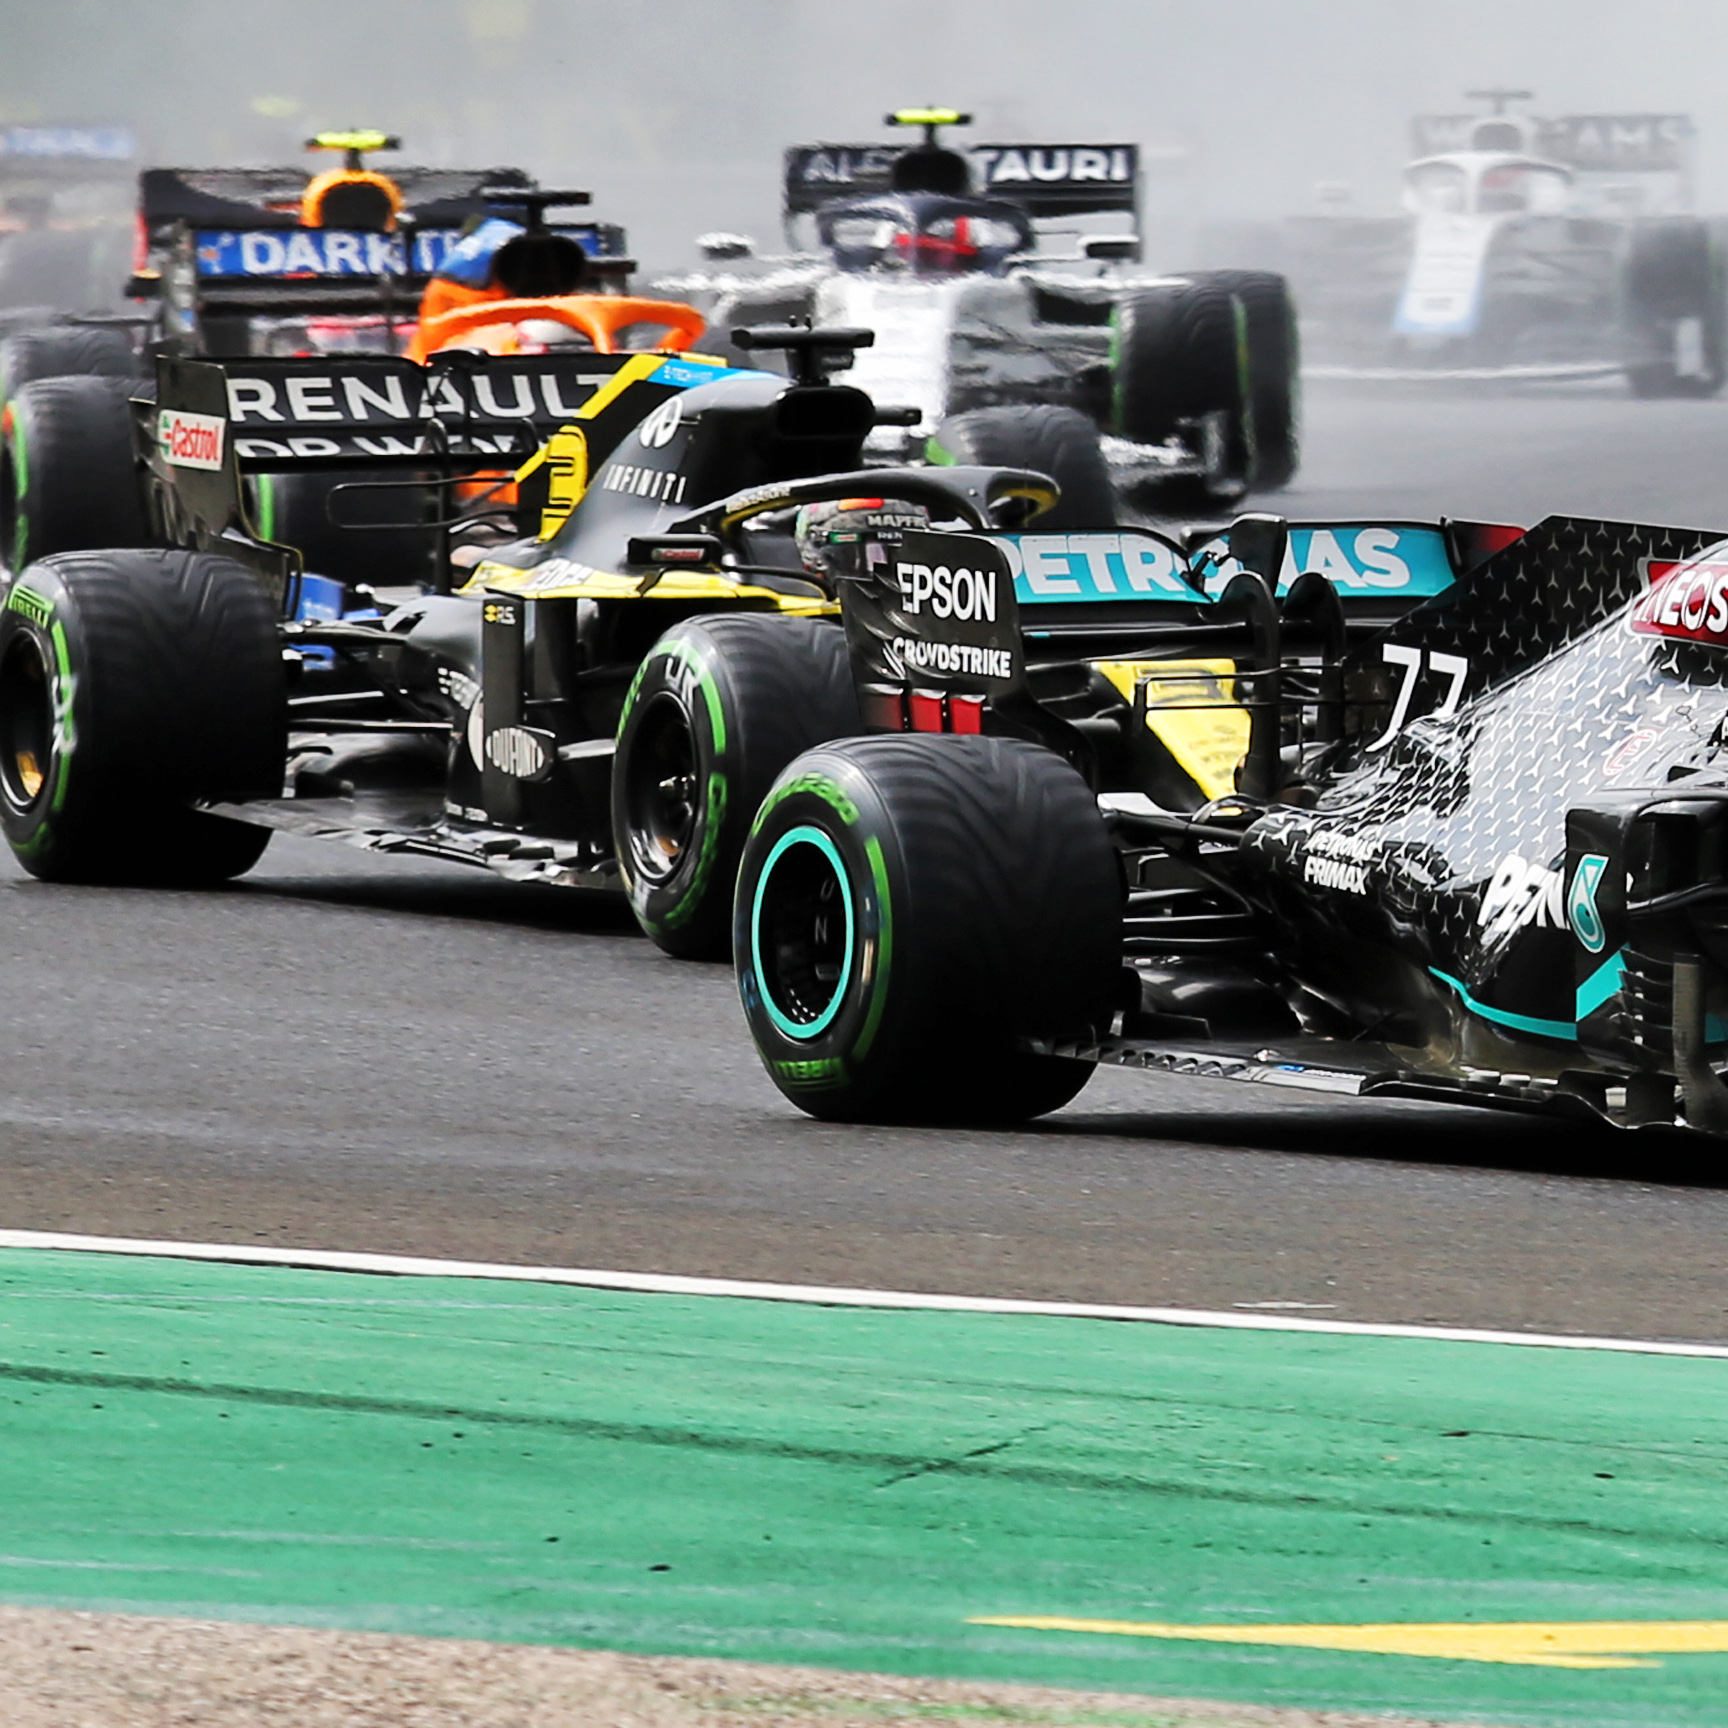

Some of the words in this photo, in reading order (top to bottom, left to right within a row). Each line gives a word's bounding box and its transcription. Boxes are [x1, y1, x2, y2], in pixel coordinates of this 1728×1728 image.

[172, 418, 219, 462] Castrol
[603, 463, 687, 504] INFINITI
[896, 562, 997, 622] EPSON
[1364, 643, 1469, 753] 77
[1304, 855, 1367, 895] PRIMAX
